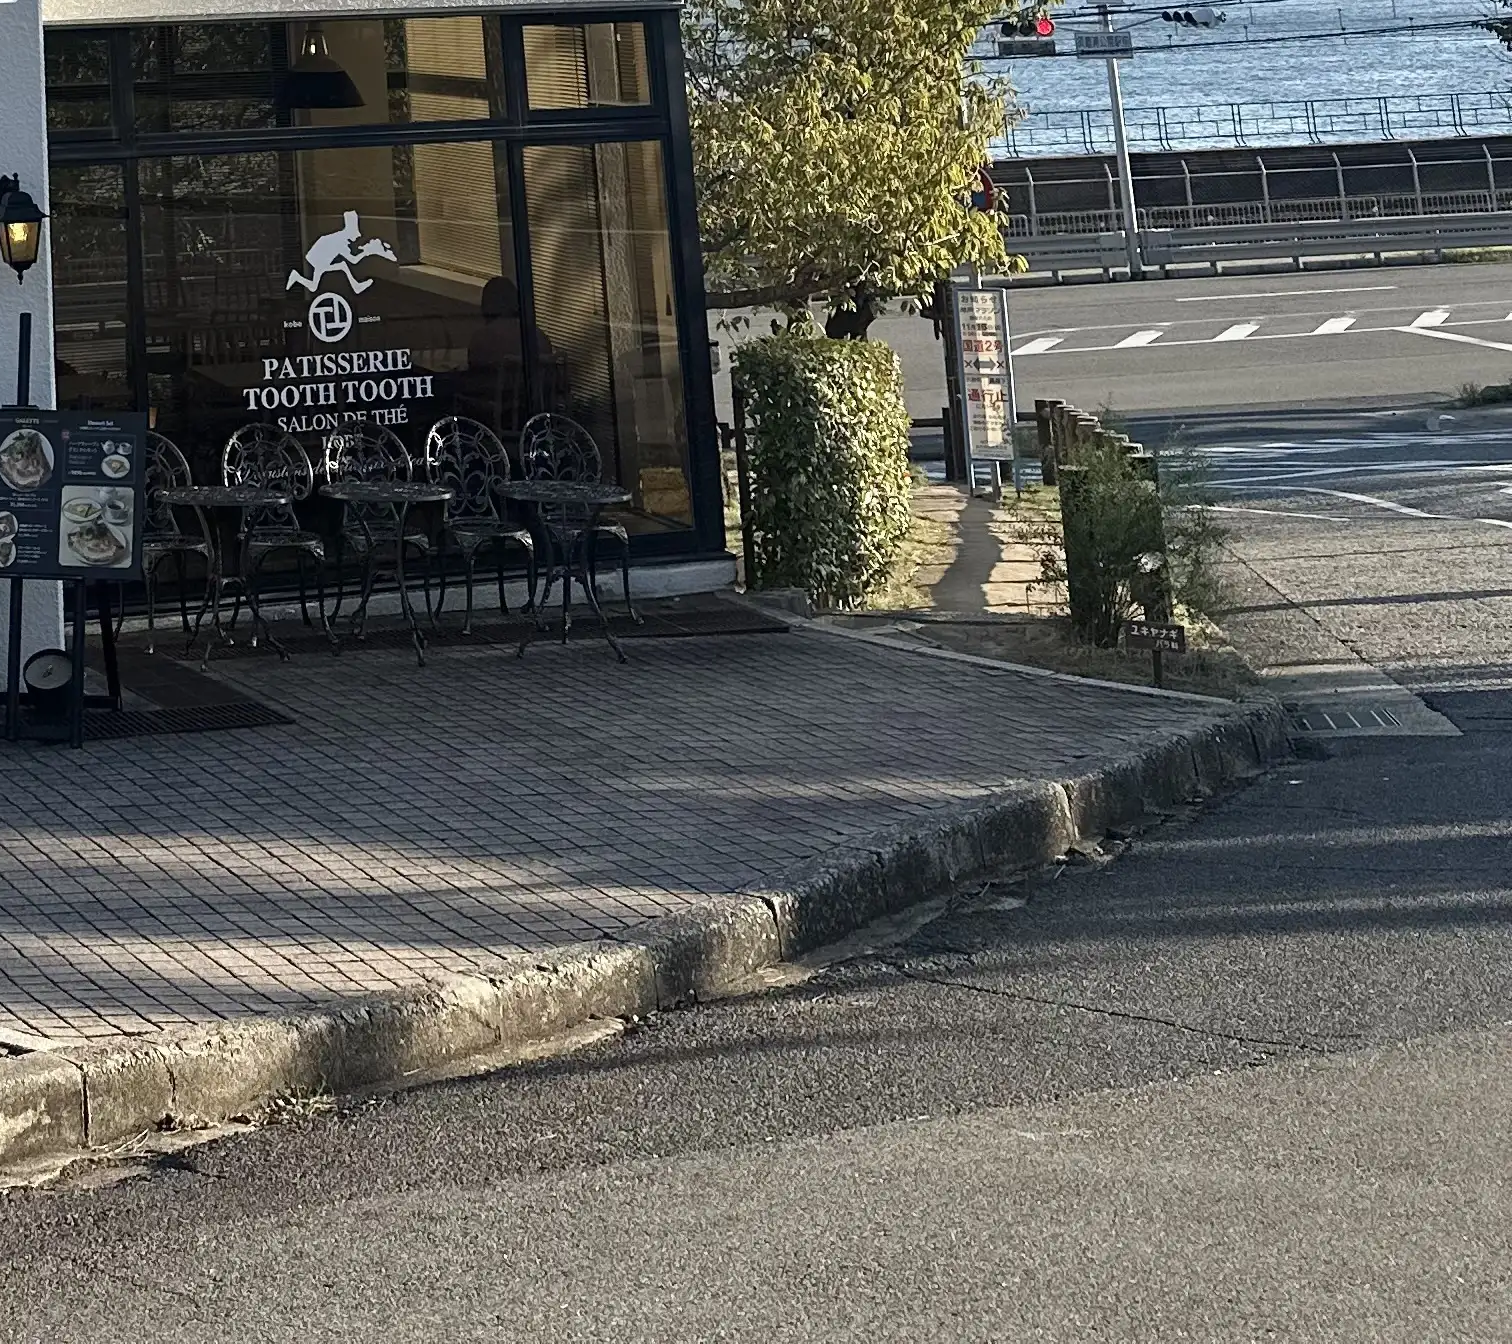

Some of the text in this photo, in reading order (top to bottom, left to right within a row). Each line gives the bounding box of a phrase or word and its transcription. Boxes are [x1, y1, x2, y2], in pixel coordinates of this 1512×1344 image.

[262, 348, 412, 380] PATISSERIE
[243, 375, 435, 411] TOOTH TOOTH
[277, 412, 338, 433] SALON
[372, 404, 409, 426] THÉ
[1131, 624, 1178, 640] ユキヤナギ
